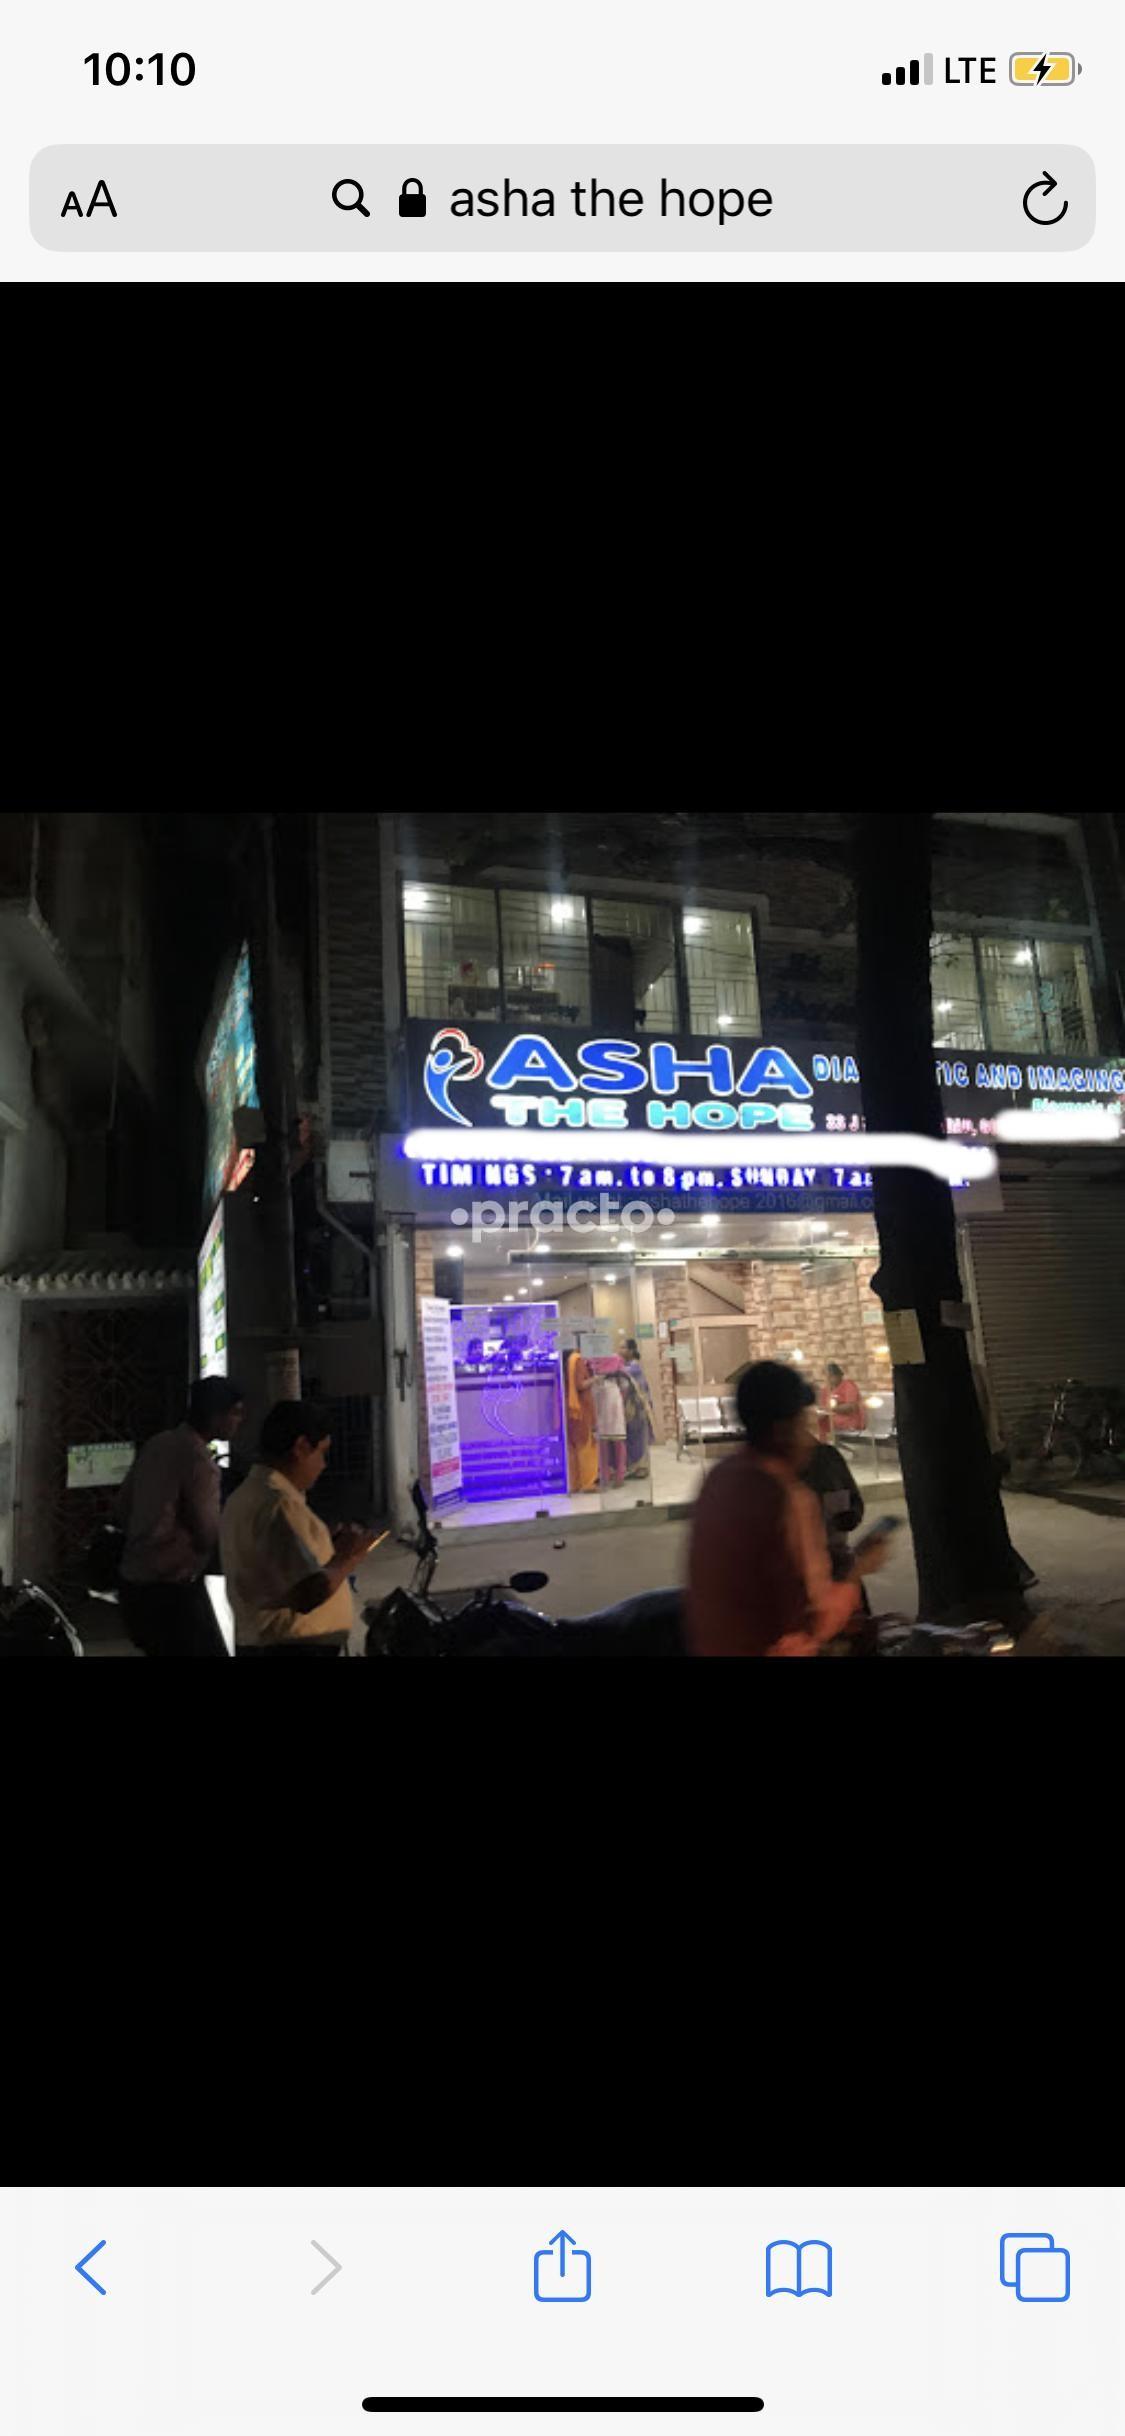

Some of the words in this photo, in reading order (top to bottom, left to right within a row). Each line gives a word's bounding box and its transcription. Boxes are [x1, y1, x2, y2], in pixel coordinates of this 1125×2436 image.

[84, 52, 196, 87] 10:10
[945, 57, 996, 84] LTE
[450, 177, 555, 217] asha
[570, 177, 644, 217] the
[661, 177, 773, 226] hope
[485, 1034, 814, 1098] ASHA
[975, 1062, 1023, 1090] AND
[1026, 1064, 1125, 1093] IMAGING
[490, 1094, 630, 1129] THE
[646, 1100, 816, 1132] HOPE
[630, 1165, 656, 1187] to
[730, 1166, 816, 1188] SUNDAY
